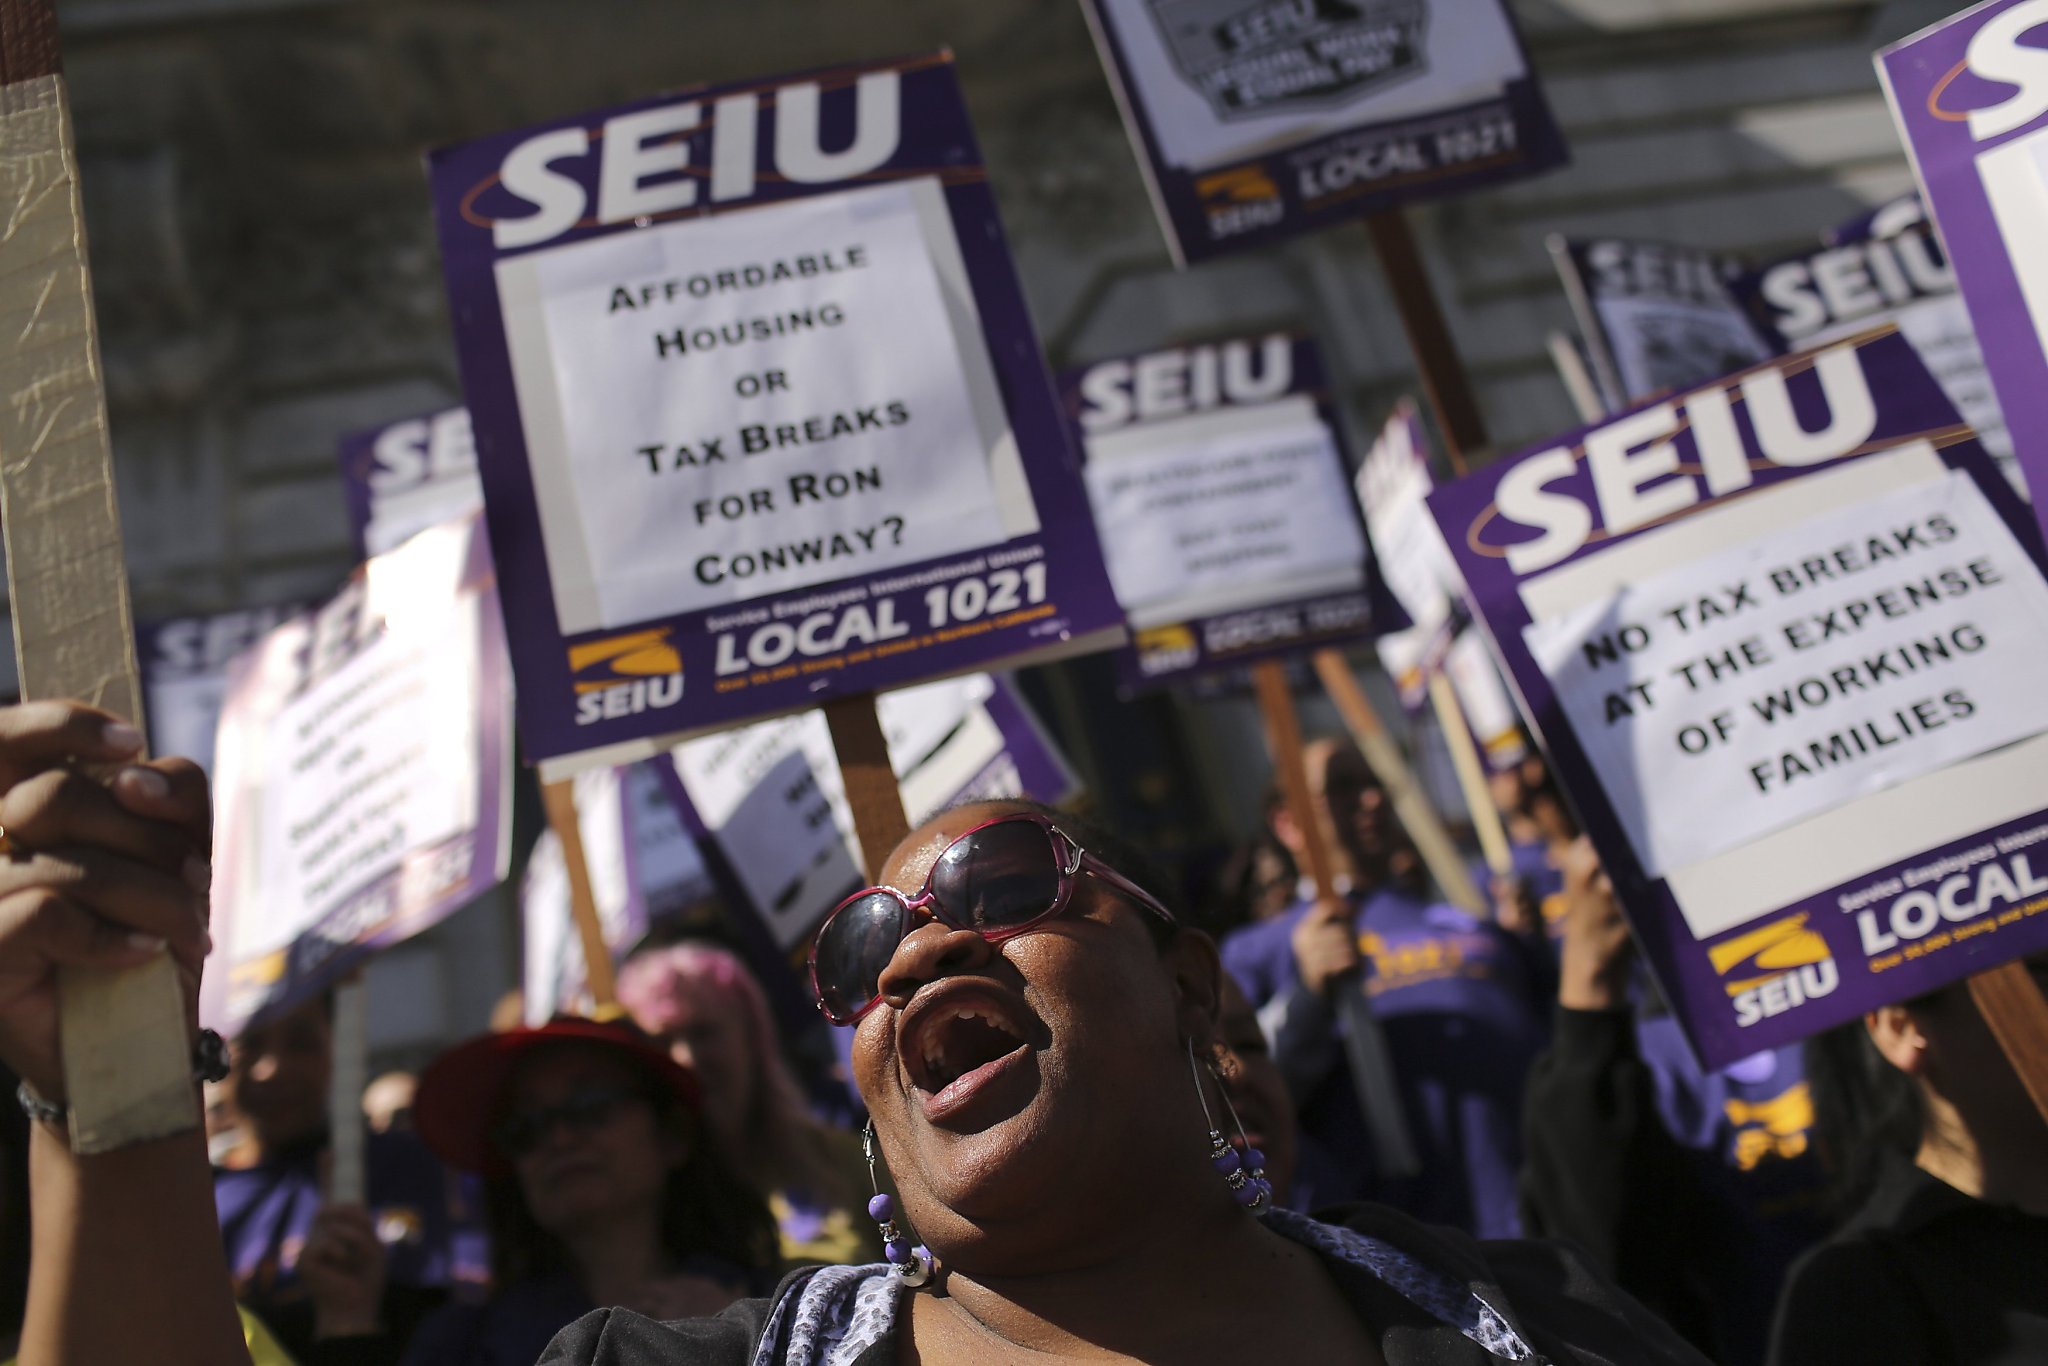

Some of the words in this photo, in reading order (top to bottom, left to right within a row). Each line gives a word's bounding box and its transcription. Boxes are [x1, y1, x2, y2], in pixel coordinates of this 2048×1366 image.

[494, 69, 901, 250] SEIU
[1299, 139, 1429, 200] LOCAL
[608, 244, 868, 314] AFFORDABLE
[1761, 229, 1955, 343] SEIU
[655, 303, 845, 359] HOUSING
[735, 369, 790, 400] OR
[1080, 333, 1293, 431] SEIU
[369, 406, 480, 492] SE
[638, 439, 727, 476] TAX
[739, 402, 911, 457] BREAKS
[1495, 343, 1878, 576] SEIU
[694, 490, 775, 527] FOR
[788, 464, 882, 506] RON
[694, 517, 906, 587] CONWAY?
[1581, 622, 1652, 671] NO
[1662, 581, 1757, 633] TAX
[1769, 511, 1960, 596] BREAKS
[715, 597, 910, 676] LOCAL
[923, 562, 1047, 629] 1021
[1603, 682, 1655, 725] AT
[1673, 633, 1774, 692] THE
[1784, 556, 2004, 650] EXPENSE
[575, 673, 684, 726] SEIU
[1677, 711, 1739, 755] OF
[1750, 622, 1987, 724] WORKING
[1749, 688, 1978, 794] FAMILIES
[1856, 853, 2048, 957] LOCAL
[1733, 956, 1840, 1028] SEIU
